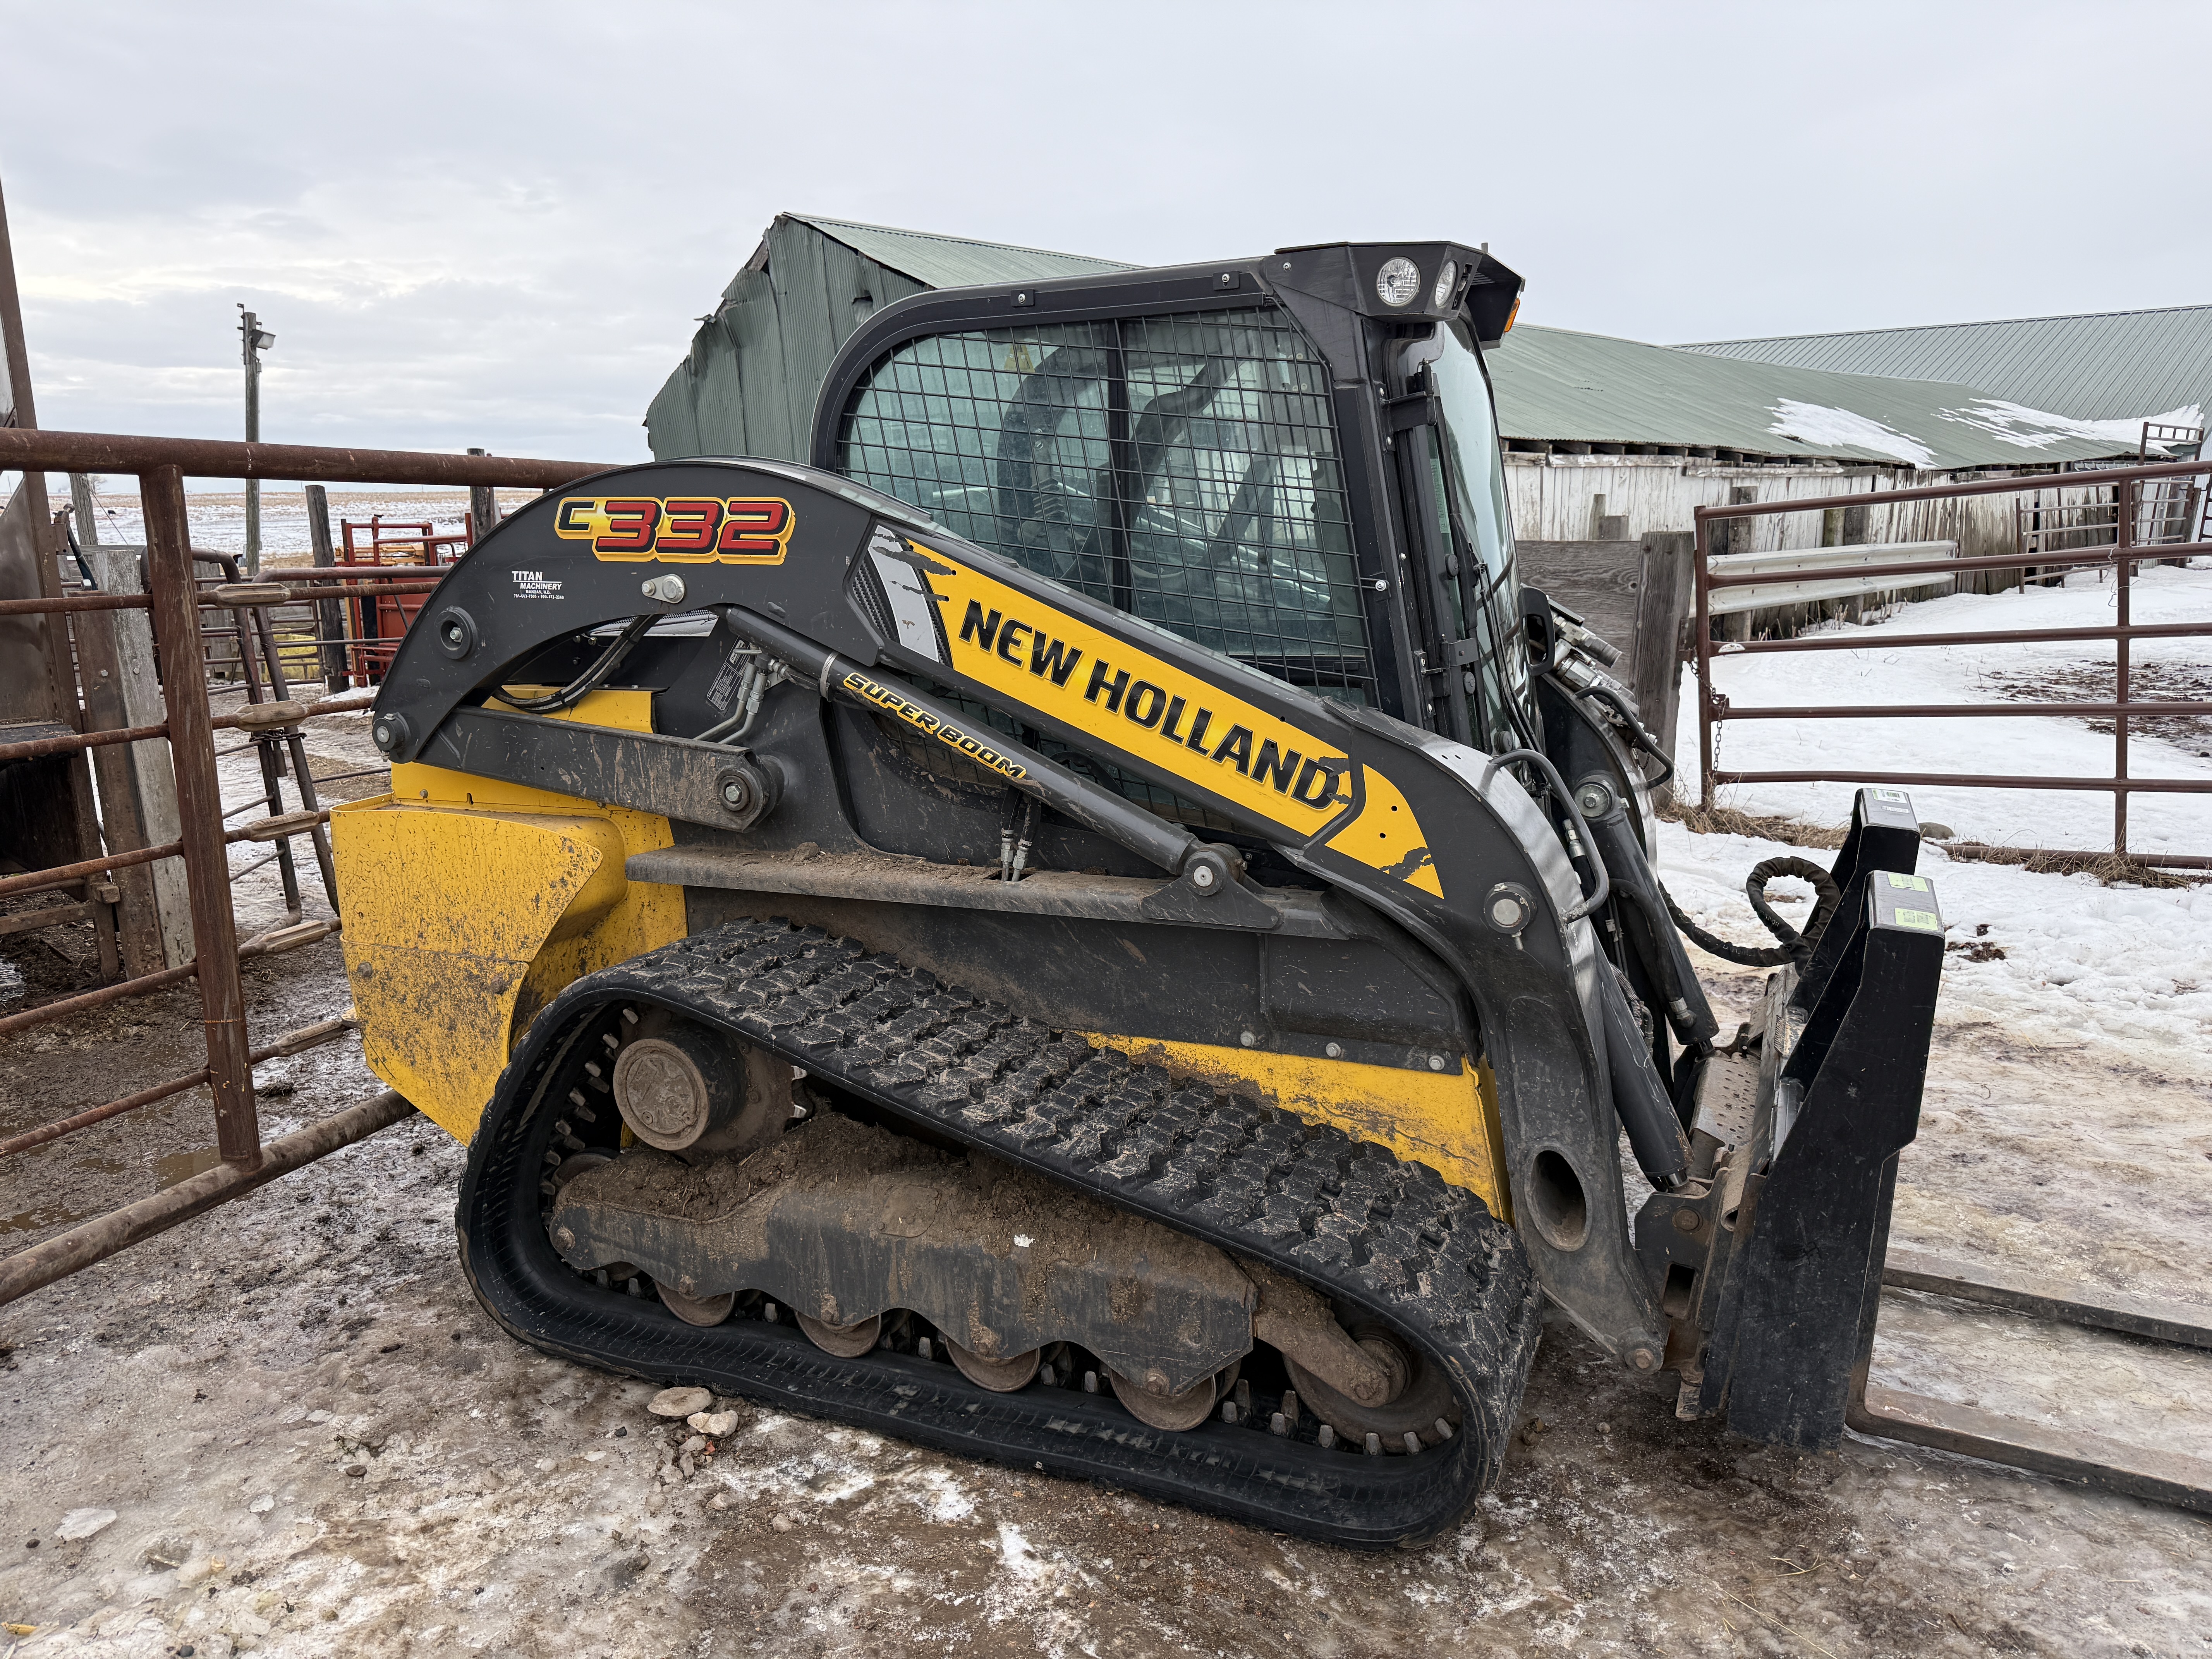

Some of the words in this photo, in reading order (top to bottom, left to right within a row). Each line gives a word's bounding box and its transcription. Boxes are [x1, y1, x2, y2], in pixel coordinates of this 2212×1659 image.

[557, 499, 793, 560] C332
[512, 571, 543, 580] TITAN
[843, 672, 940, 735] SUPER
[938, 725, 1026, 778] BOOM
[958, 599, 1082, 688] NEW
[1084, 658, 1340, 810] HOLLAND
